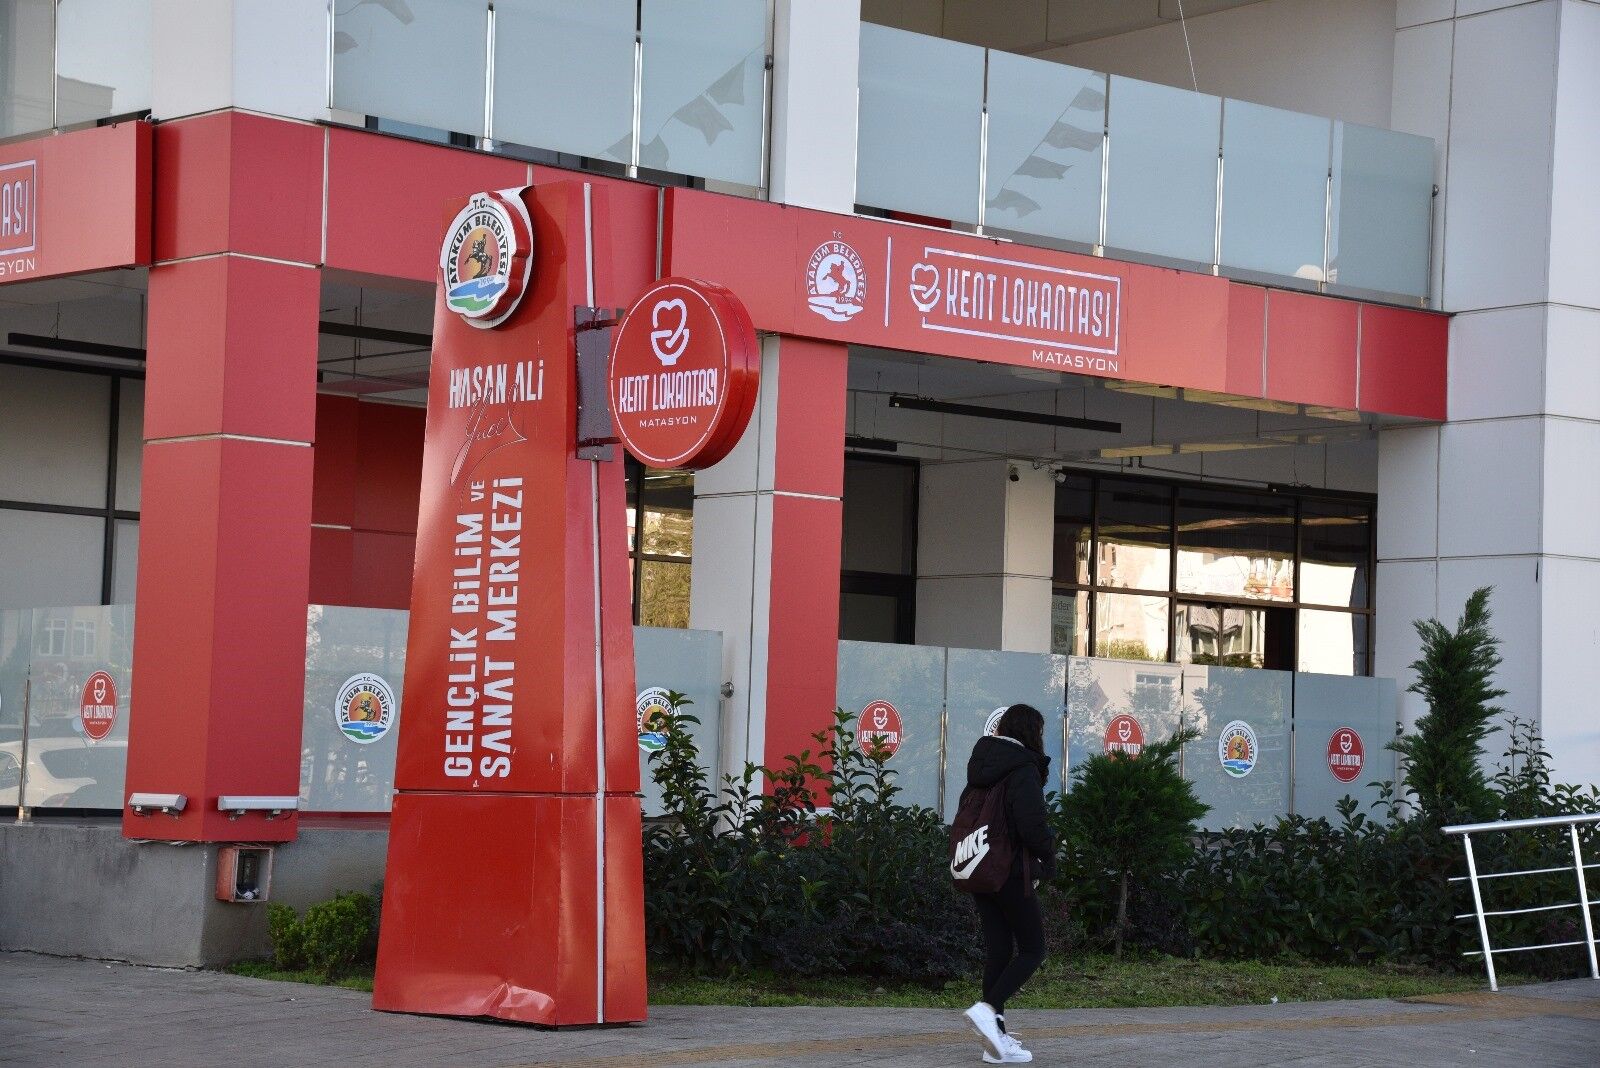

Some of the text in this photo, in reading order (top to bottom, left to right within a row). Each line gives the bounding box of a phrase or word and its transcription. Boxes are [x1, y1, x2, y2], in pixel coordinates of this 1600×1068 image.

[473, 198, 488, 210] T.C.
[450, 214, 507, 284] ATAKUM BELEDİYESİ
[808, 245, 830, 295] ATAKUM
[946, 267, 1112, 338] KENT LOKANTASI
[1032, 350, 1118, 373] MATASYON
[449, 365, 508, 409] HASAN
[619, 368, 718, 413] KENT LOKANTASI
[639, 416, 697, 428] MATASYON
[444, 479, 485, 778] GENÇLİK BİLİM VE
[479, 477, 524, 779] SANAT MERKEZİ
[343, 687, 361, 722] ATAKUM
[954, 825, 990, 867] NIKE
